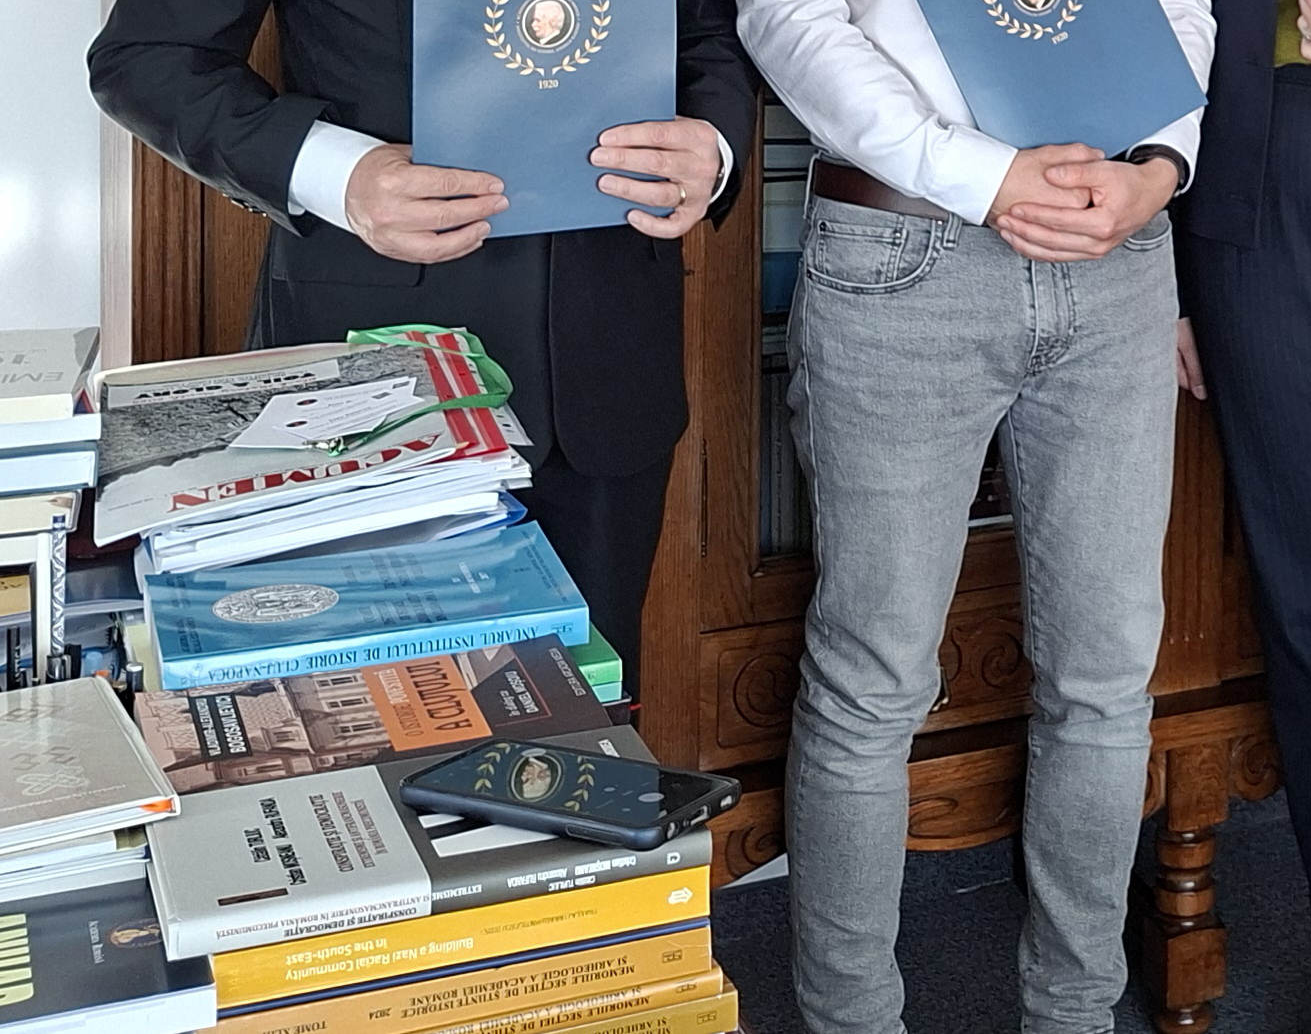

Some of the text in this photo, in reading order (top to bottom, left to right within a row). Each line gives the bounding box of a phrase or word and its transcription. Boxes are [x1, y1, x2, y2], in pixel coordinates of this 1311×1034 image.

[538, 79, 559, 89] 1920
[166, 434, 442, 514] ACUMEN
[387, 635, 476, 657] INSTITUTULUI
[480, 626, 538, 646] ANUARUL
[305, 651, 357, 668] ISTORIE
[362, 647, 381, 660] DE
[208, 658, 300, 682] CLUJ-NAPOCA
[406, 661, 472, 730] A CLUJULUI
[285, 944, 352, 966] South-East
[354, 940, 374, 956] the
[285, 937, 474, 981] Building a Nazi Racial Community
[530, 974, 536, 983] A
[542, 959, 615, 983] ARHEOLOGIE
[572, 965, 635, 985] MEMORIILE
[463, 975, 526, 996] ACADEMIEI
[504, 986, 519, 998] DE
[409, 988, 458, 1007] ROMÂNE
[587, 996, 649, 1017] MEMORIILE
[400, 1001, 454, 1018] ISTORICE
[520, 1021, 535, 1032] DE
